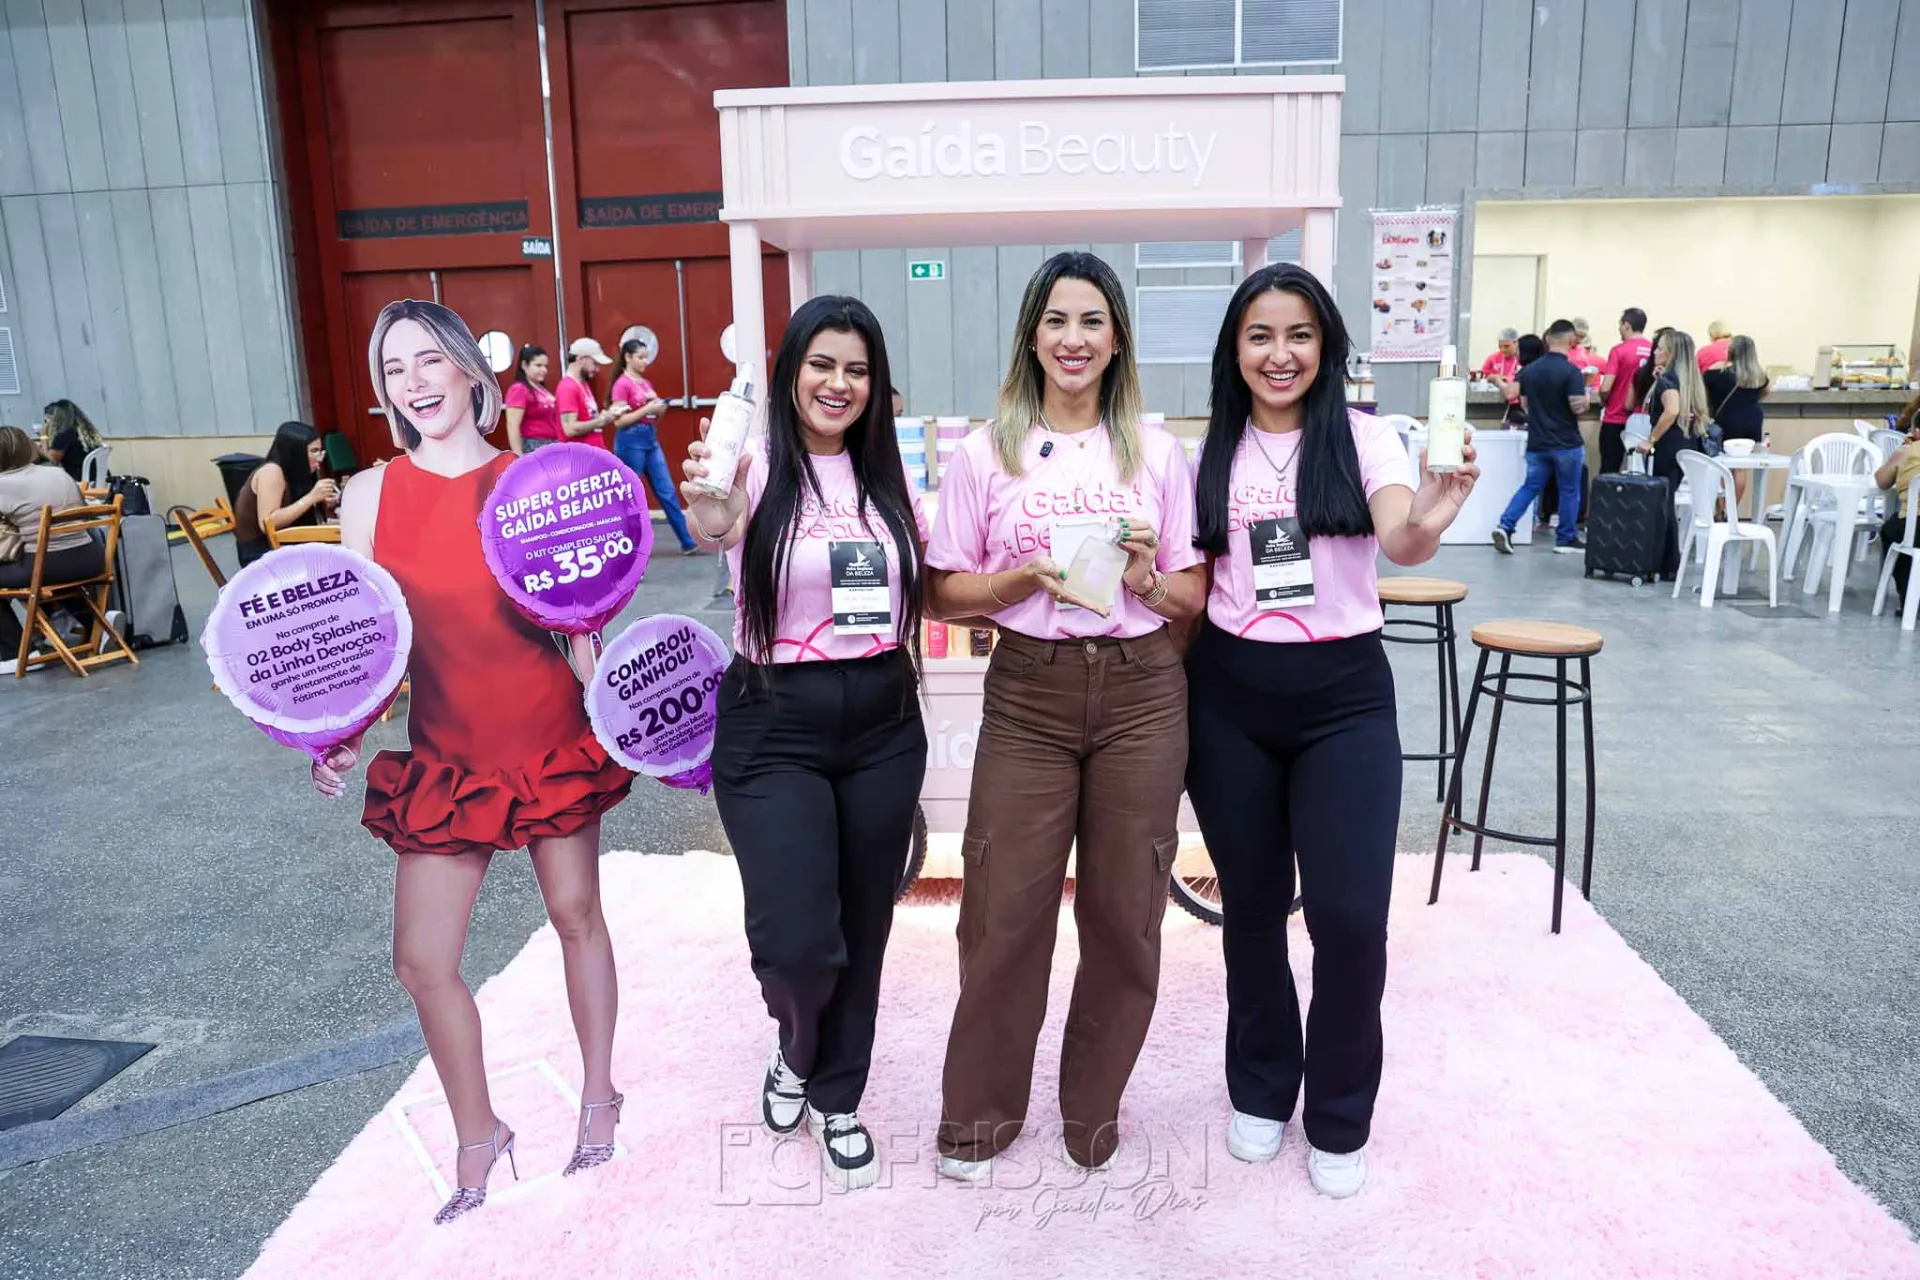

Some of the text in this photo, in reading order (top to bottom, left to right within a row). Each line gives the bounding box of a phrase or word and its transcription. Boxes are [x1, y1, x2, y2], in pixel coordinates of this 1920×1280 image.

[839, 121, 1218, 186] Gaída Beauty
[395, 216, 416, 231] DE
[421, 210, 527, 230] EMERGÊNCIA
[584, 204, 635, 223] SAÍDA
[640, 204, 663, 219] DE
[522, 238, 552, 255] SAÍDA
[495, 468, 623, 522] SUPER OFERTA
[501, 482, 633, 539] GAÍDA BEAUTY!
[525, 530, 624, 560] O KIT COMPLETO SAI POR
[524, 537, 634, 594] R$ 35,00
[239, 569, 359, 618] FÉ E BELEZA
[246, 587, 360, 630] EM UMA SÓ PROMOÇÃO!
[247, 616, 377, 666] 02 Body Splashes
[276, 614, 340, 640] Na compra de
[249, 631, 386, 683] da Linha Devoção,
[270, 648, 375, 691] ganhe um terço trazido
[607, 626, 696, 688] COMPROU,
[619, 644, 695, 701] GANHOU!
[292, 664, 361, 693] diretamente de
[293, 687, 329, 704] Fátima,
[629, 702, 643, 711] Nas
[643, 686, 672, 704] compras
[671, 676, 692, 689] acima
[616, 727, 642, 751] R$
[653, 729, 674, 745] ganhe
[675, 721, 690, 732] uma
[653, 741, 668, 752] uma
[659, 748, 669, 756] da
